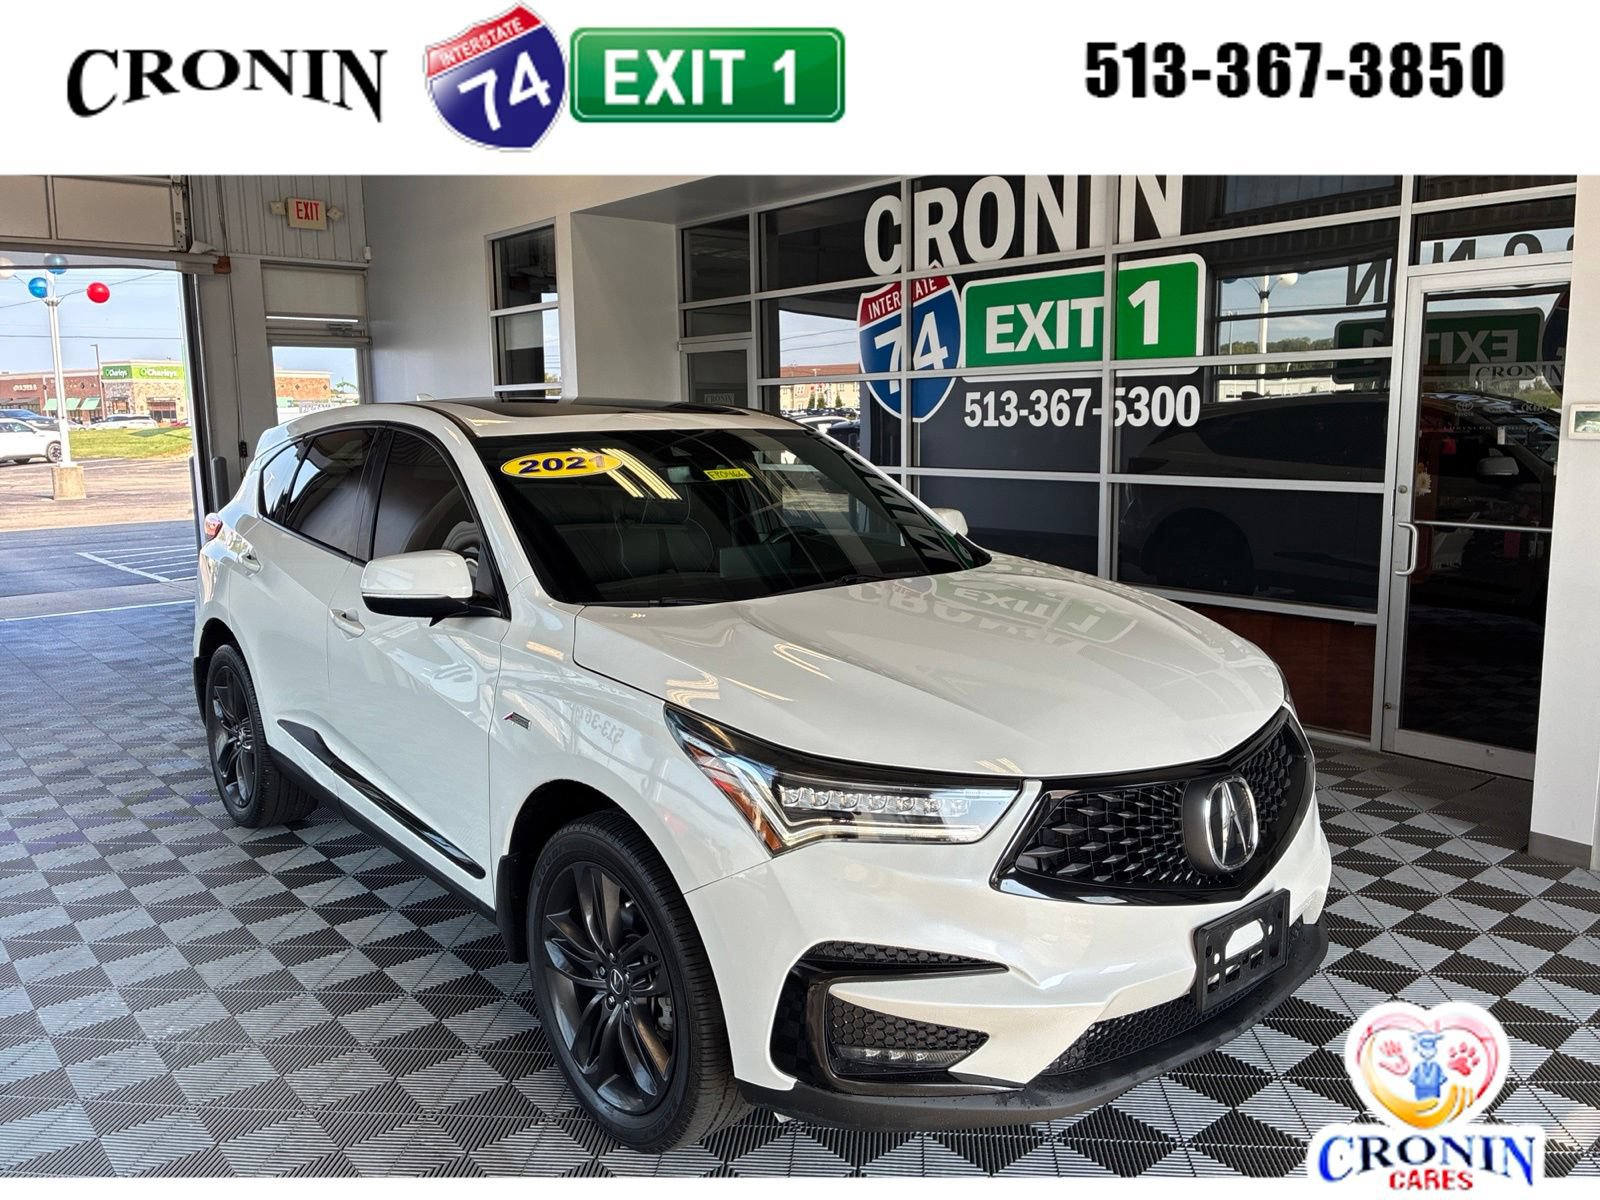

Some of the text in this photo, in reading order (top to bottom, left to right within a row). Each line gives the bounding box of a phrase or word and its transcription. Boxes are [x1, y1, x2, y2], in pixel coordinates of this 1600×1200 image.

[295, 201, 319, 220] EXIT
[864, 175, 1183, 276] CRONIN
[986, 280, 1160, 354] EXIT 1
[874, 311, 949, 395] 74
[964, 384, 1200, 427] 513-367-5300
[519, 456, 605, 474] 2021
